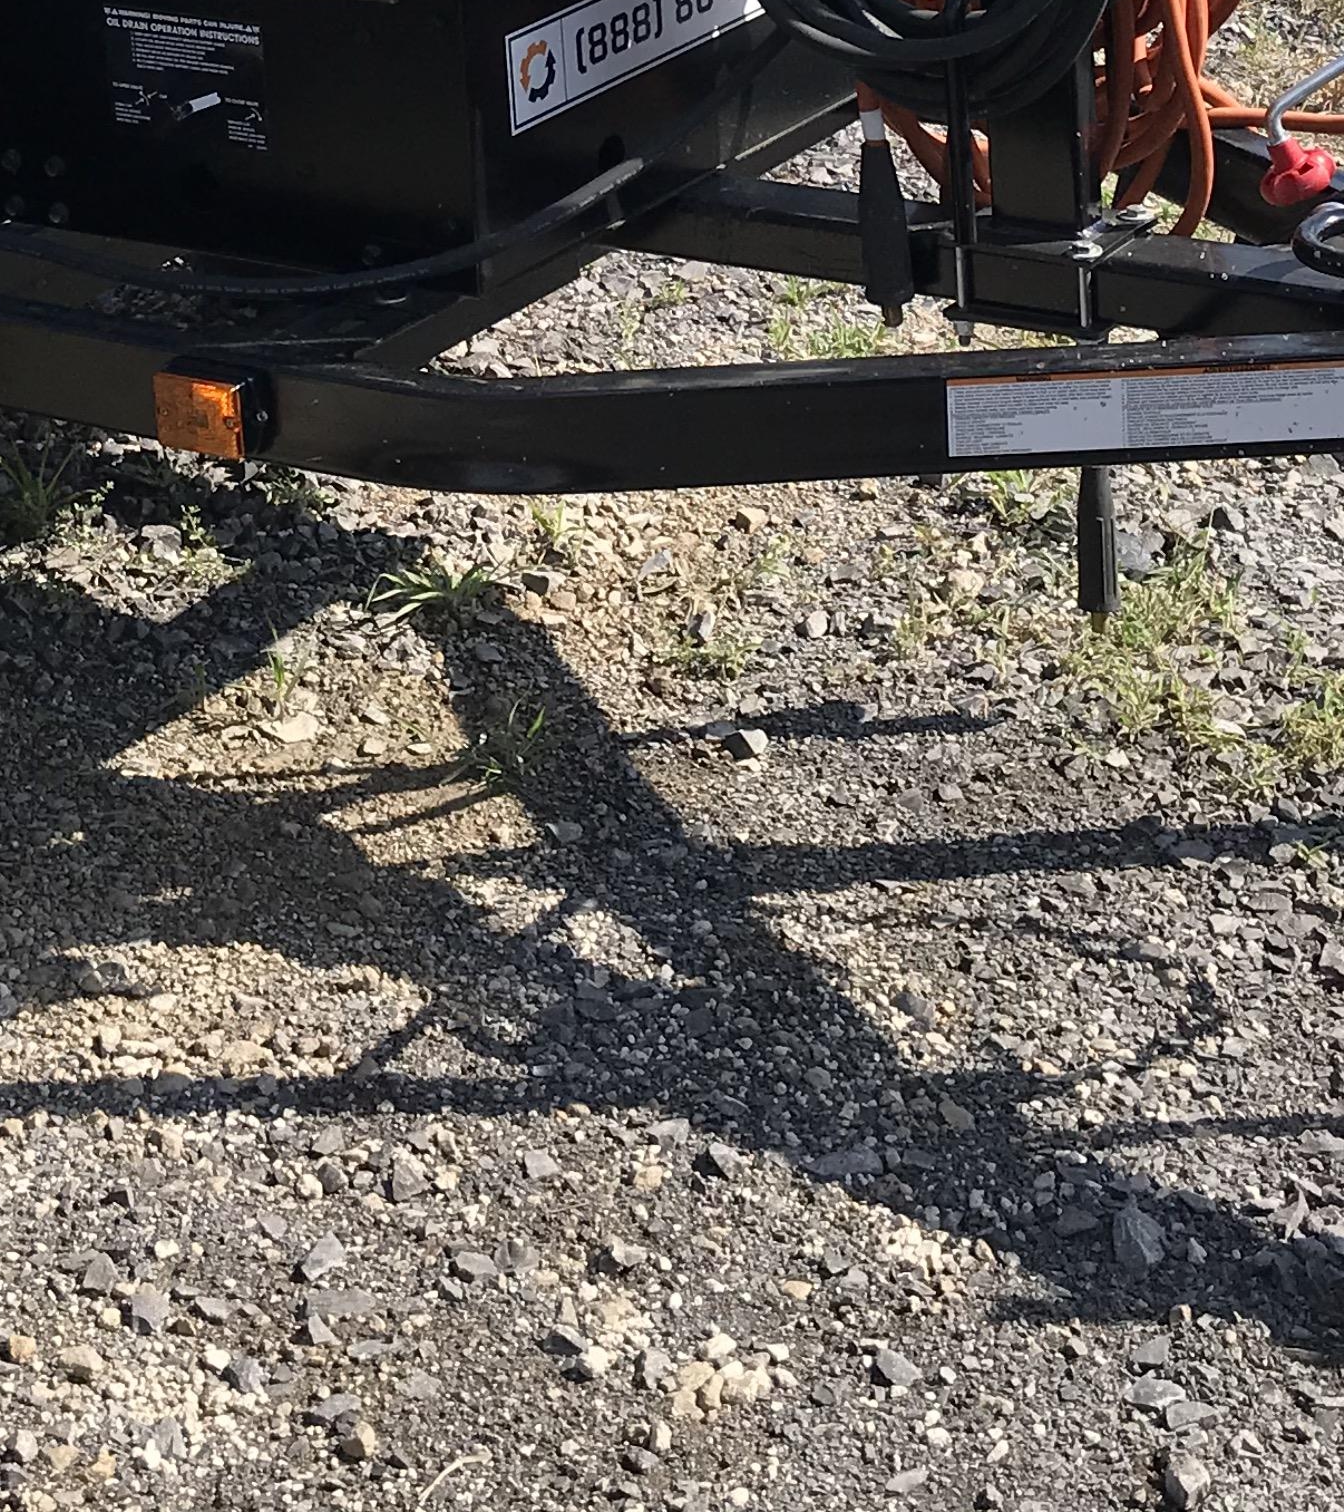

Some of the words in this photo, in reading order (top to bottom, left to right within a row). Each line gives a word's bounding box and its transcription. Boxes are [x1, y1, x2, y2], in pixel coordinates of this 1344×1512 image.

[106, 17, 121, 28] OIL
[122, 19, 149, 31] DRAIN
[150, 23, 198, 38] OPERATION
[199, 29, 260, 46] INSTRUCTIONS
